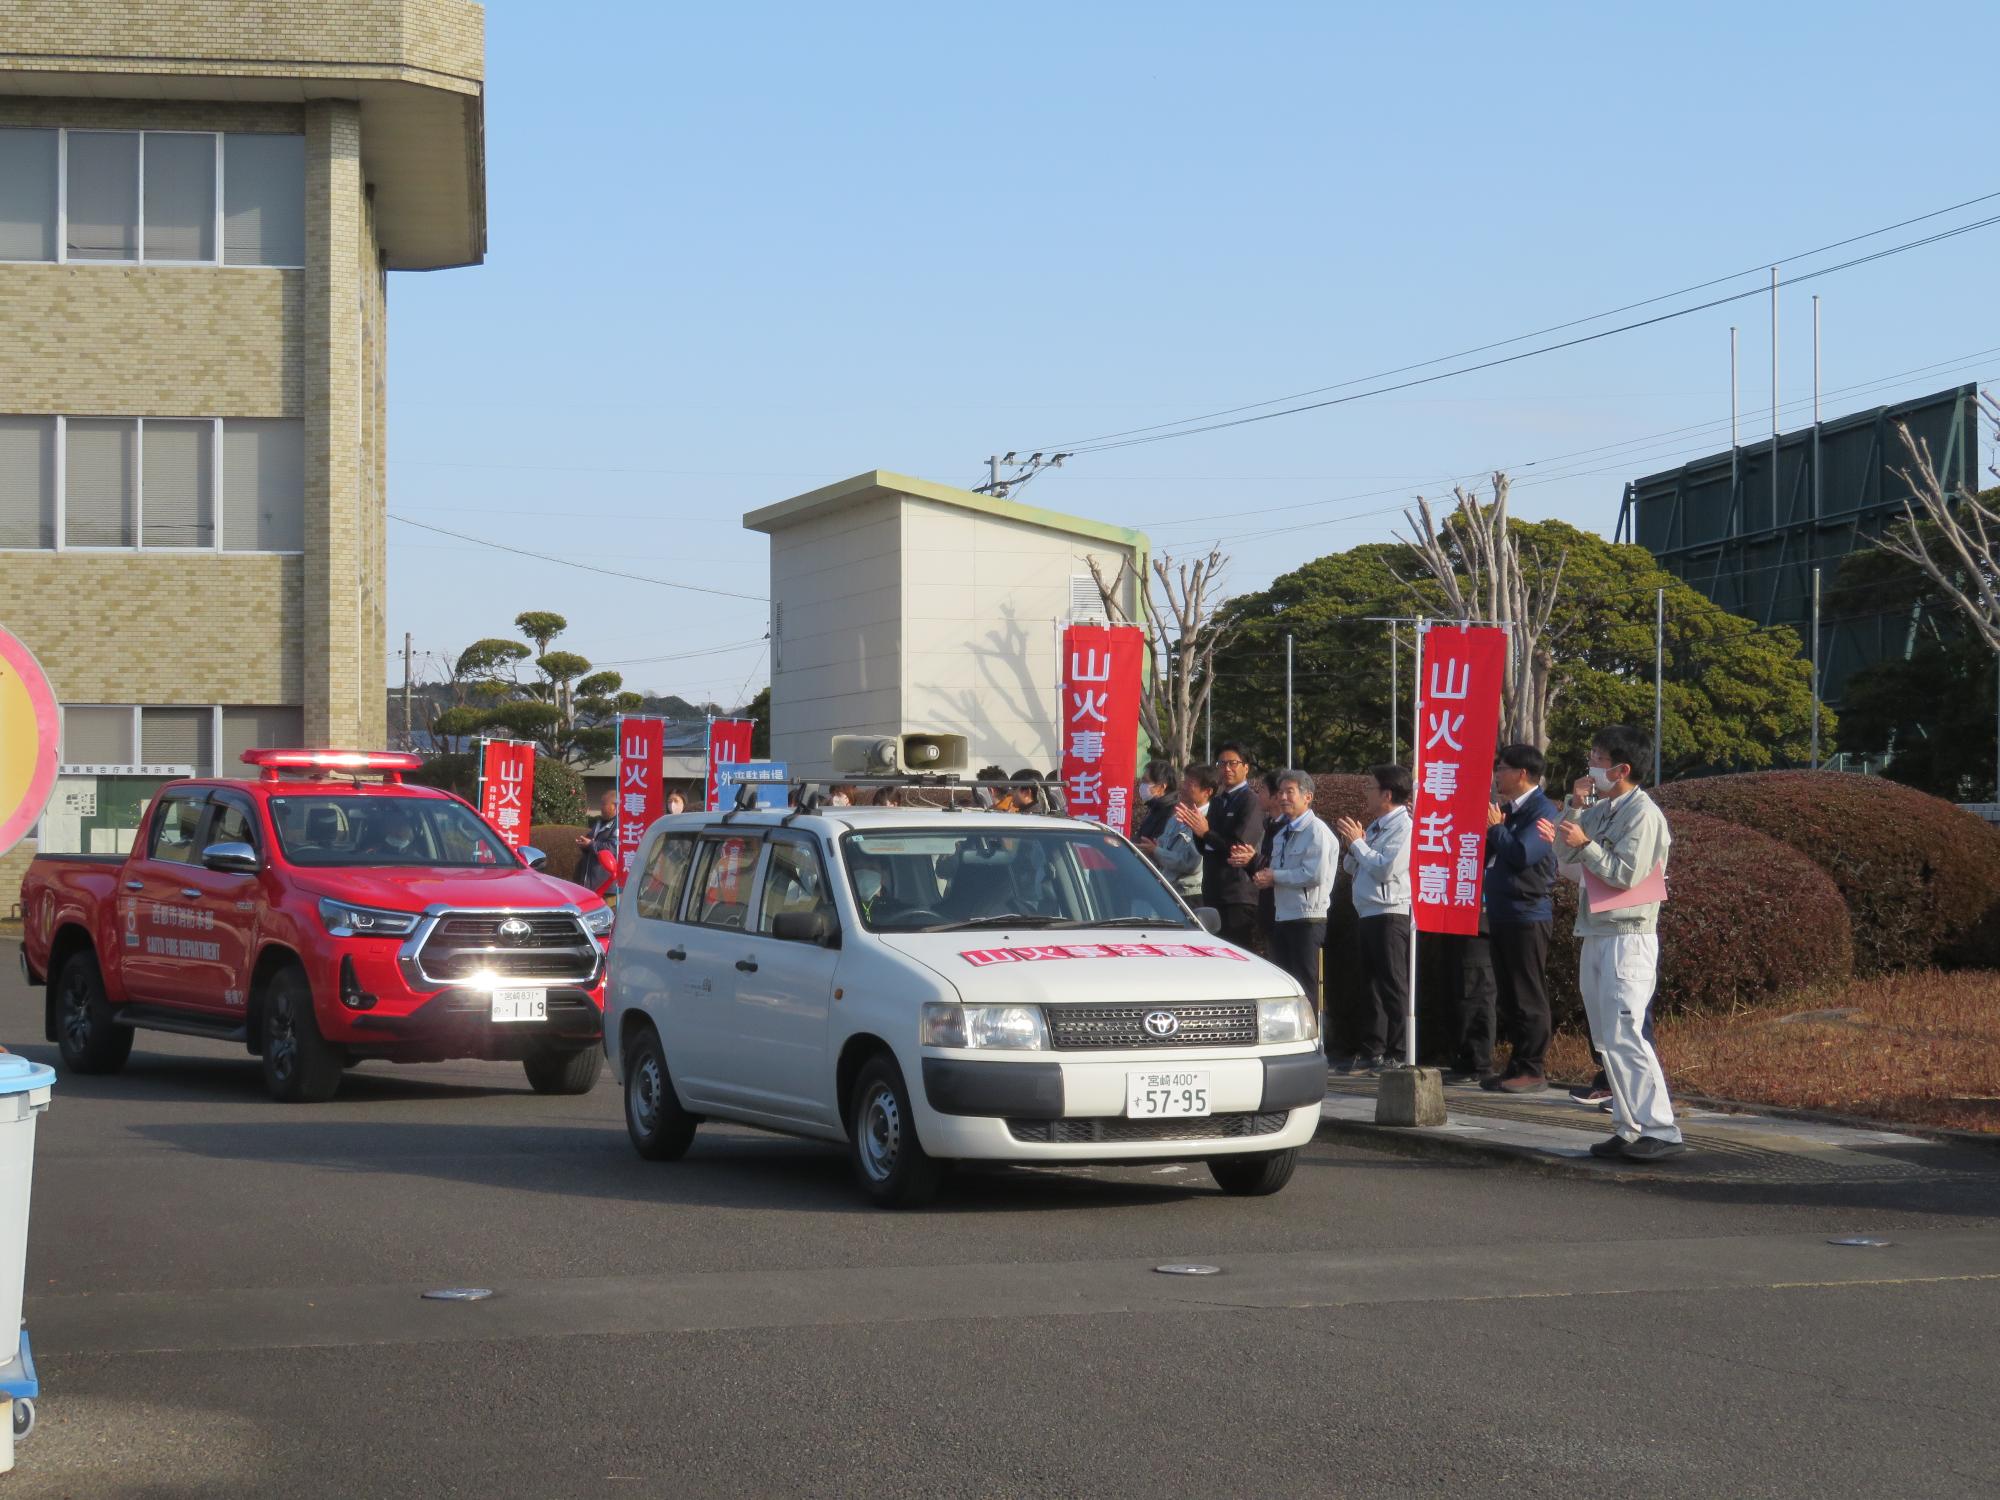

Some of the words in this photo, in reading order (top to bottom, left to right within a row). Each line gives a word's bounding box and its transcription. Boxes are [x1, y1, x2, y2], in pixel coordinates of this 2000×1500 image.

[1148, 1074, 1171, 1087] 宮崎
[1173, 1074, 1193, 1086] 400
[1146, 1089, 1206, 1114] 57-95
